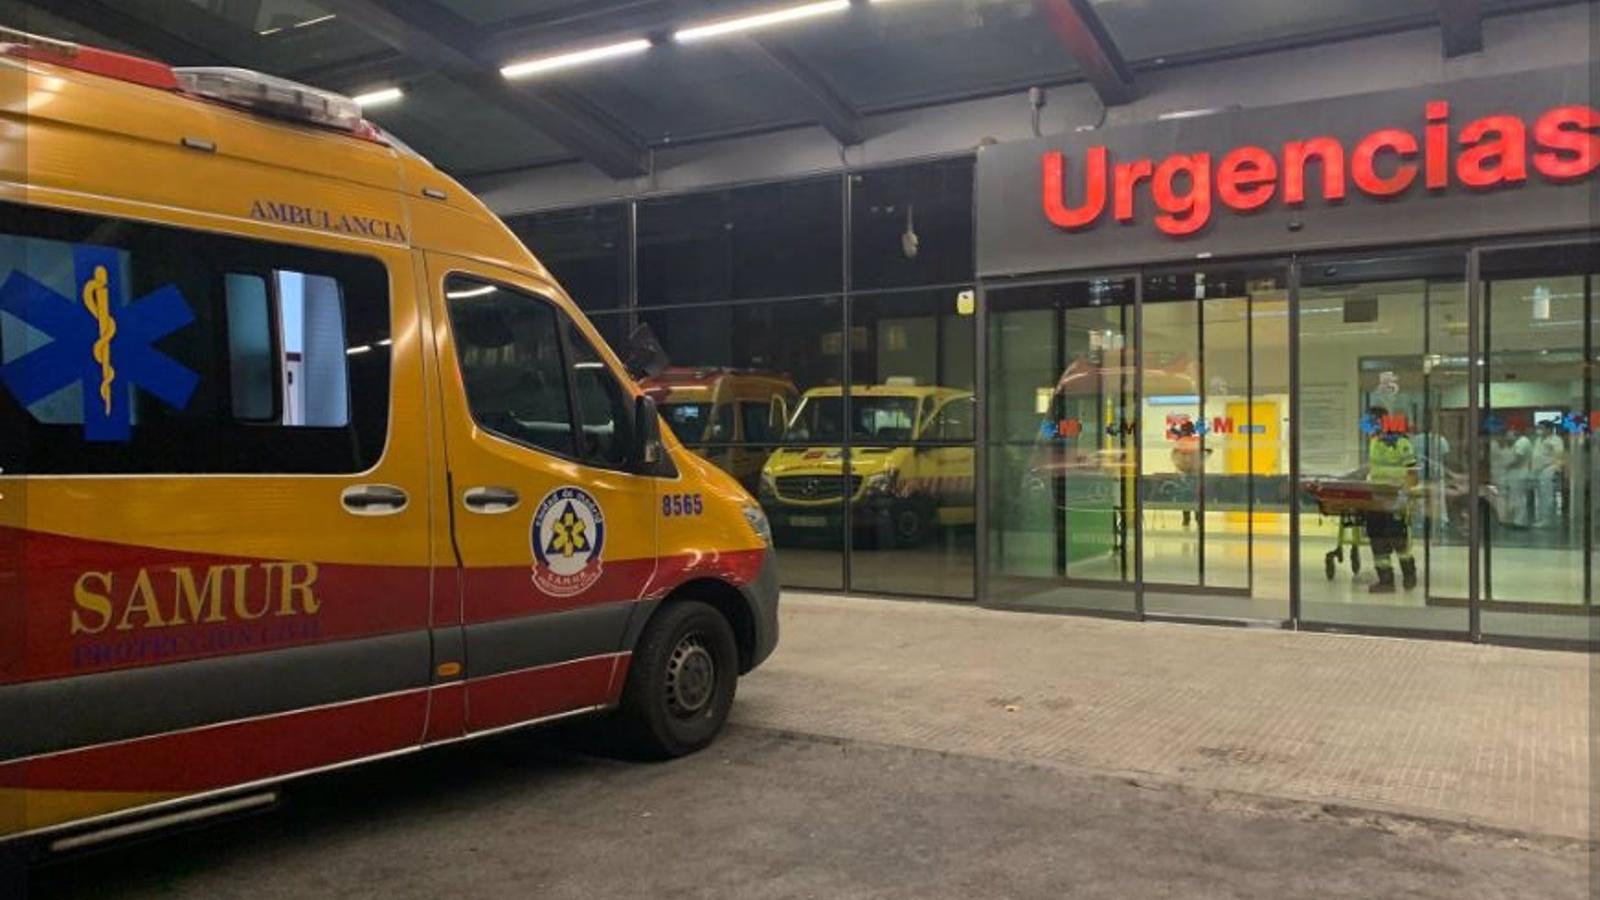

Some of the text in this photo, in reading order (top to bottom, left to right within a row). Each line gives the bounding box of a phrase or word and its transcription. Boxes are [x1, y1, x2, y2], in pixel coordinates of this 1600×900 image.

[1042, 101, 1600, 236] Urgencias
[250, 199, 407, 243] AMBULANCIA
[662, 494, 704, 517] 8565
[70, 561, 320, 635] SAMUR
